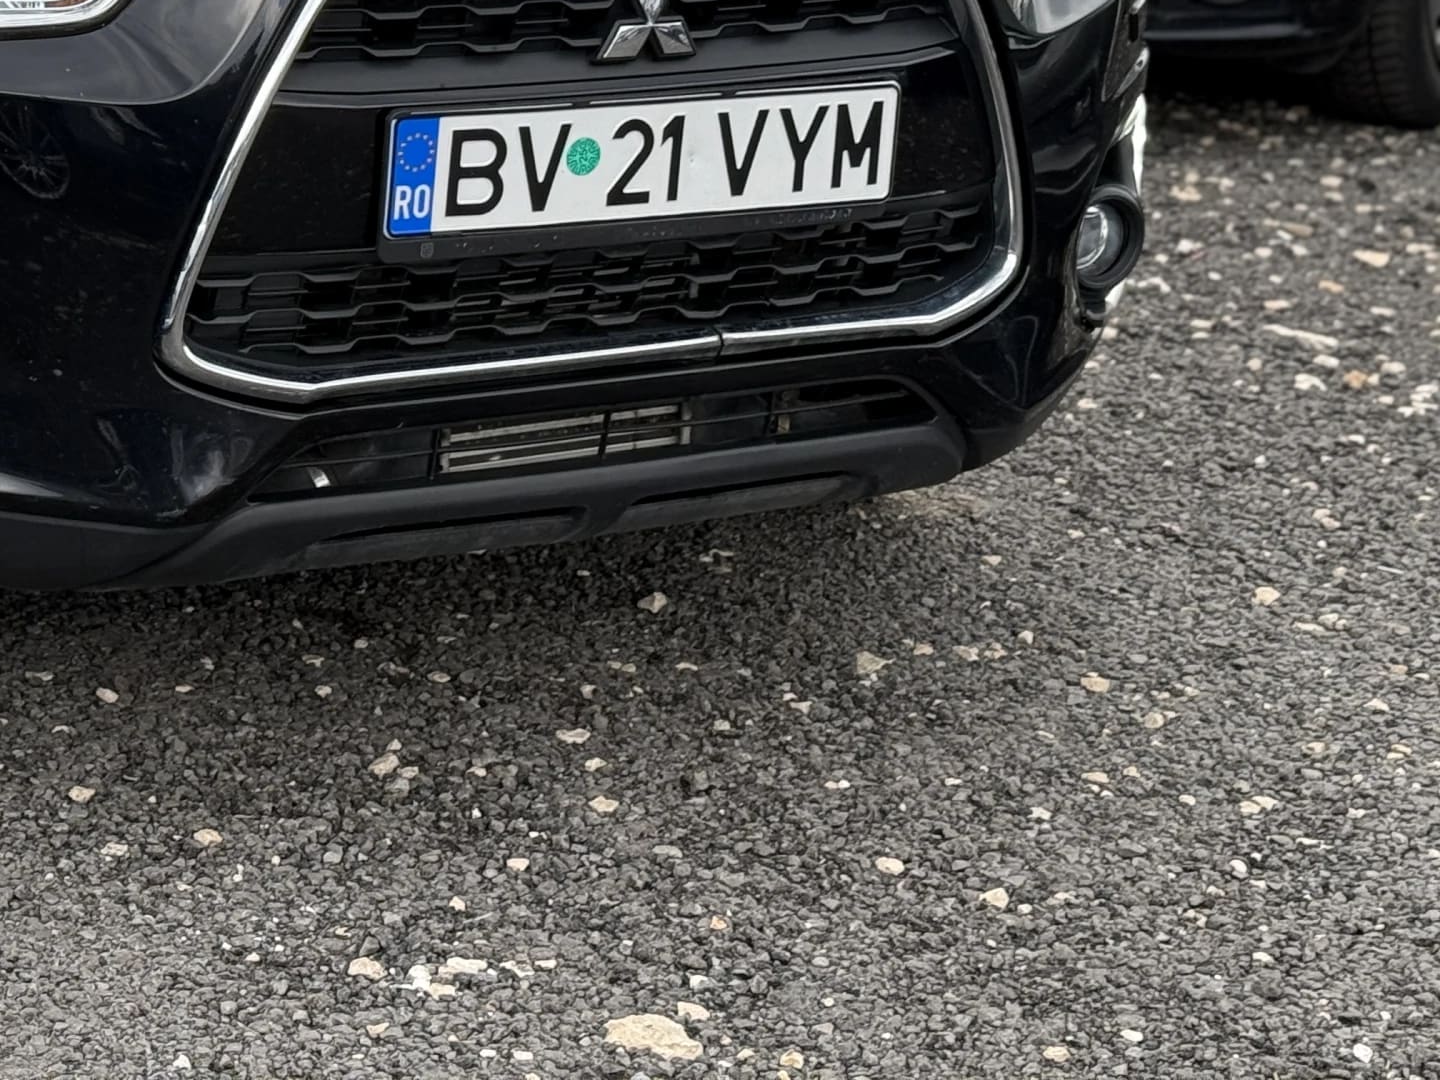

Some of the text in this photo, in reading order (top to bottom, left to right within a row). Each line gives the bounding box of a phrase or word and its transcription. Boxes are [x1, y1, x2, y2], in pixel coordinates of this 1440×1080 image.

[394, 184, 431, 220] RO
[444, 123, 572, 218] BV
[605, 114, 687, 207] 21
[717, 98, 884, 197] VYM
